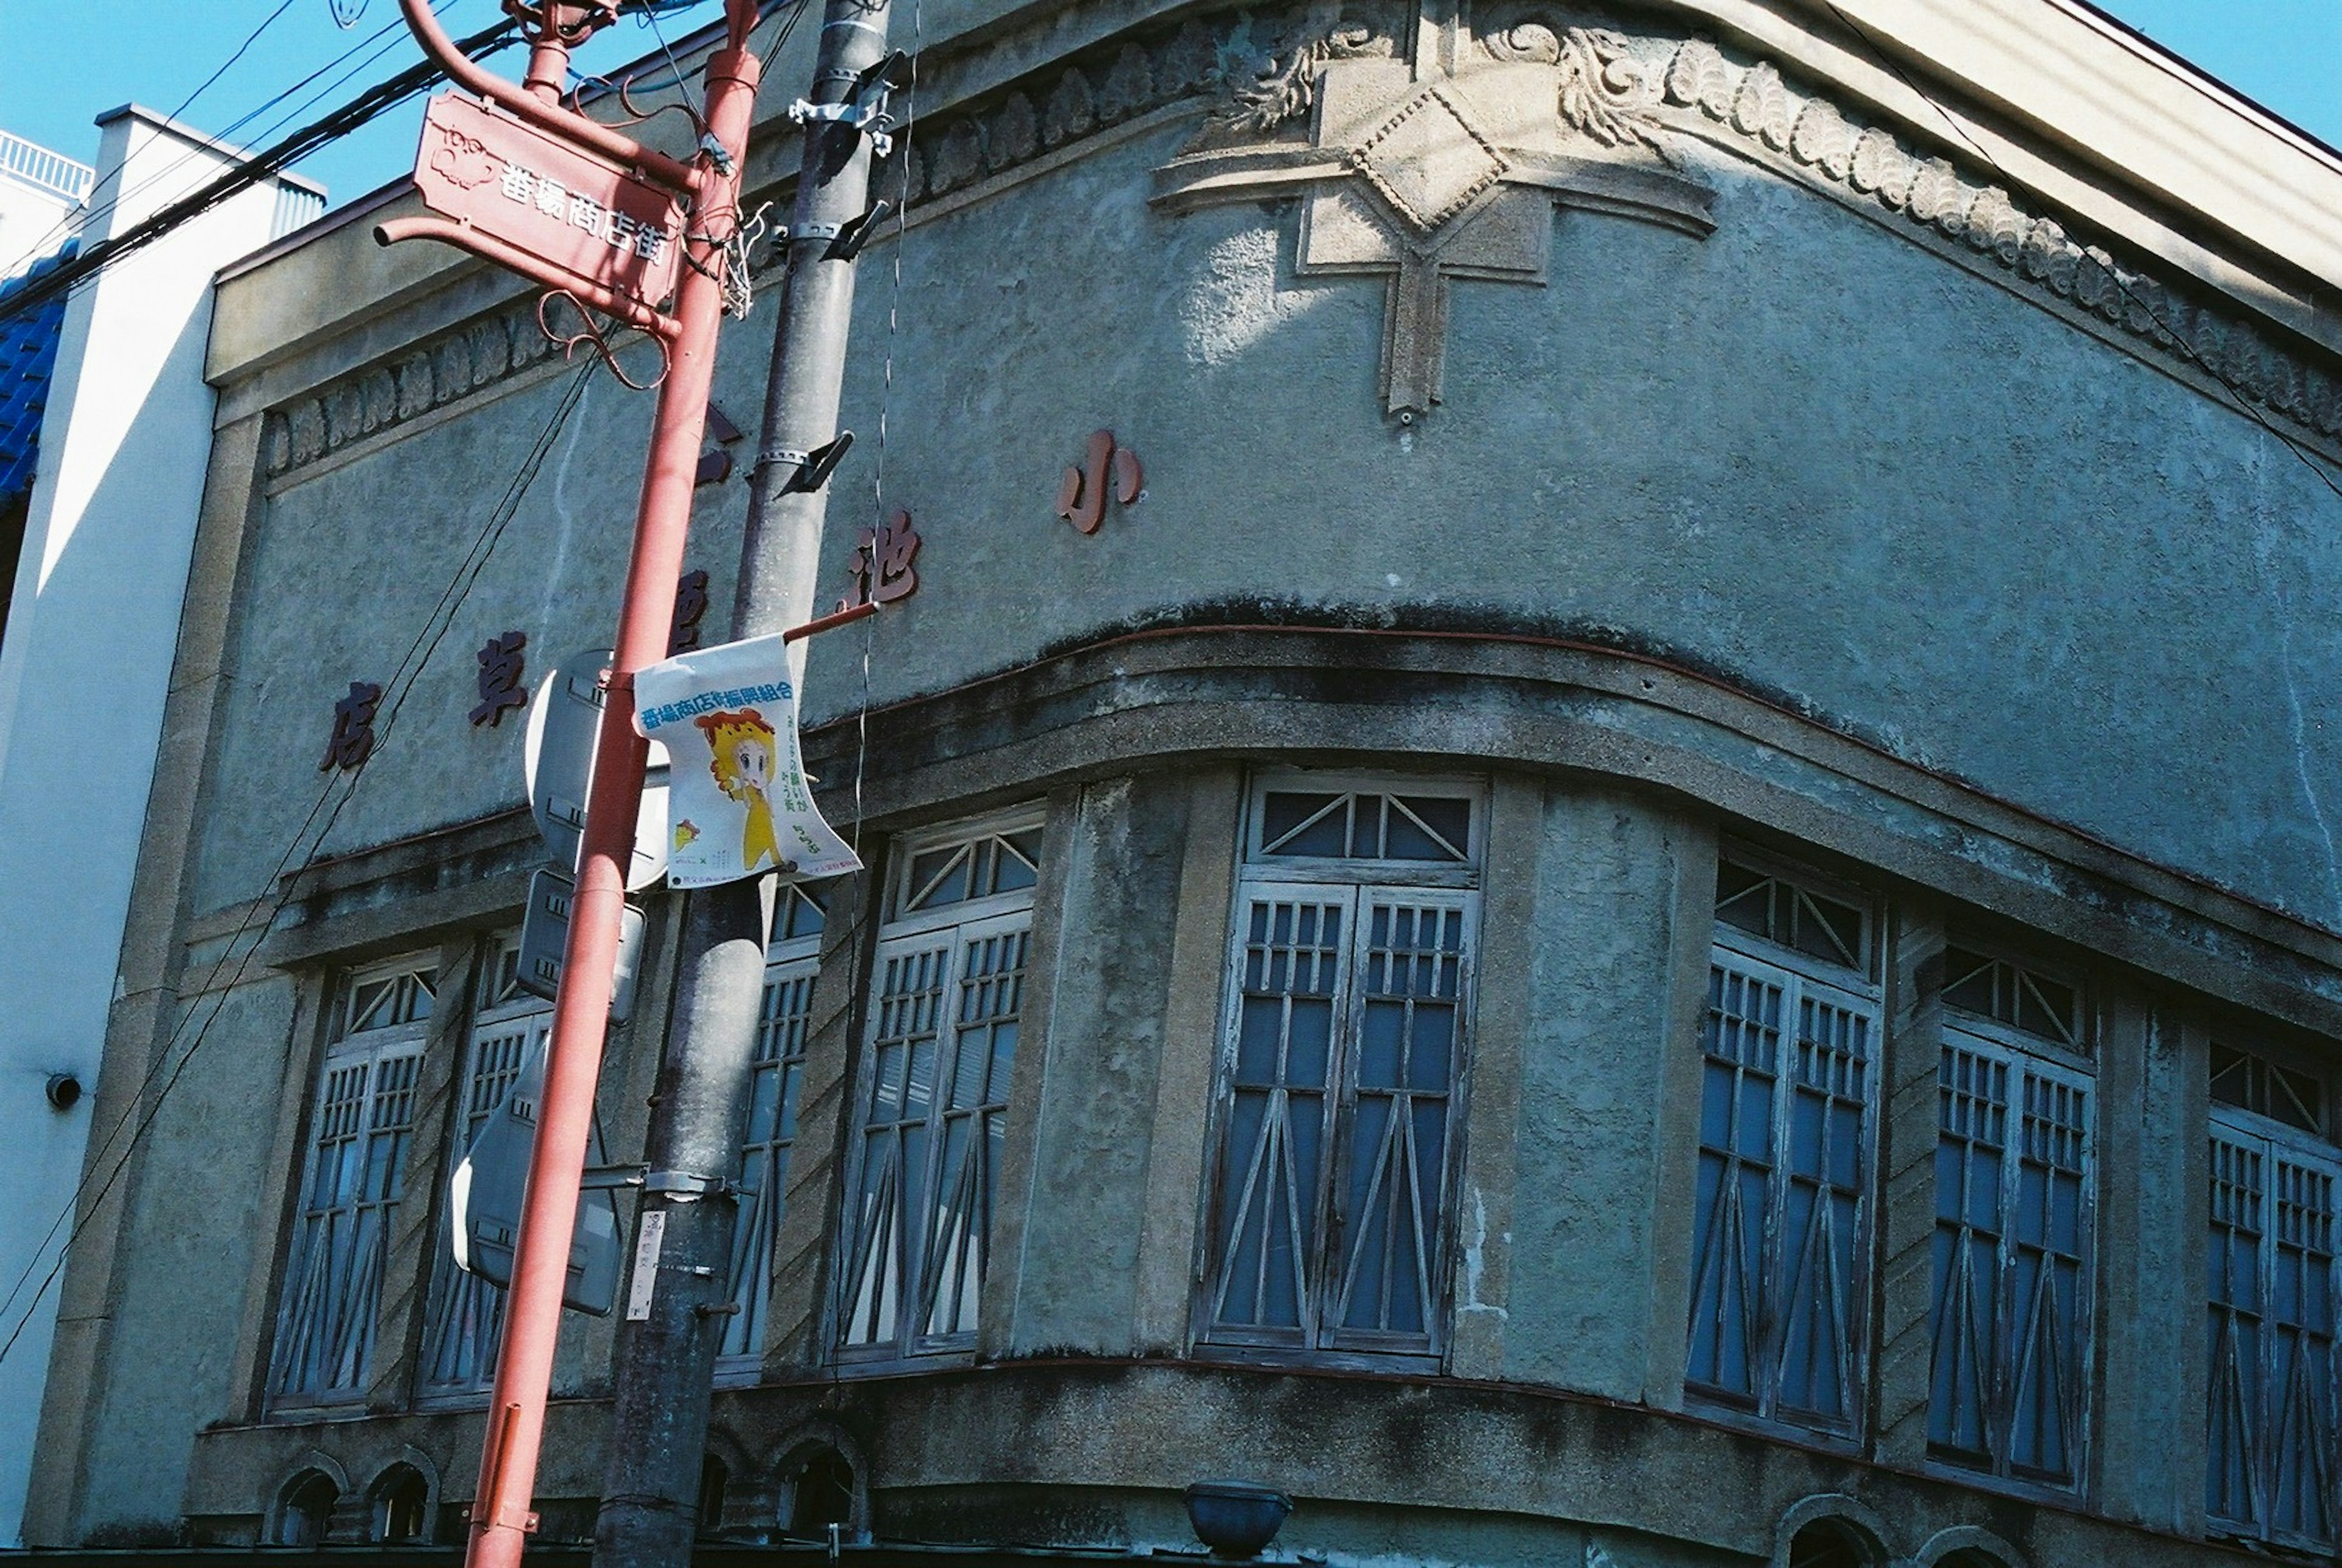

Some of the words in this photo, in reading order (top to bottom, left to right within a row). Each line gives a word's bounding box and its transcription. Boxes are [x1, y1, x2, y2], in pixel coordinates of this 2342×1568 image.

[499, 162, 669, 266] 番場商店街
